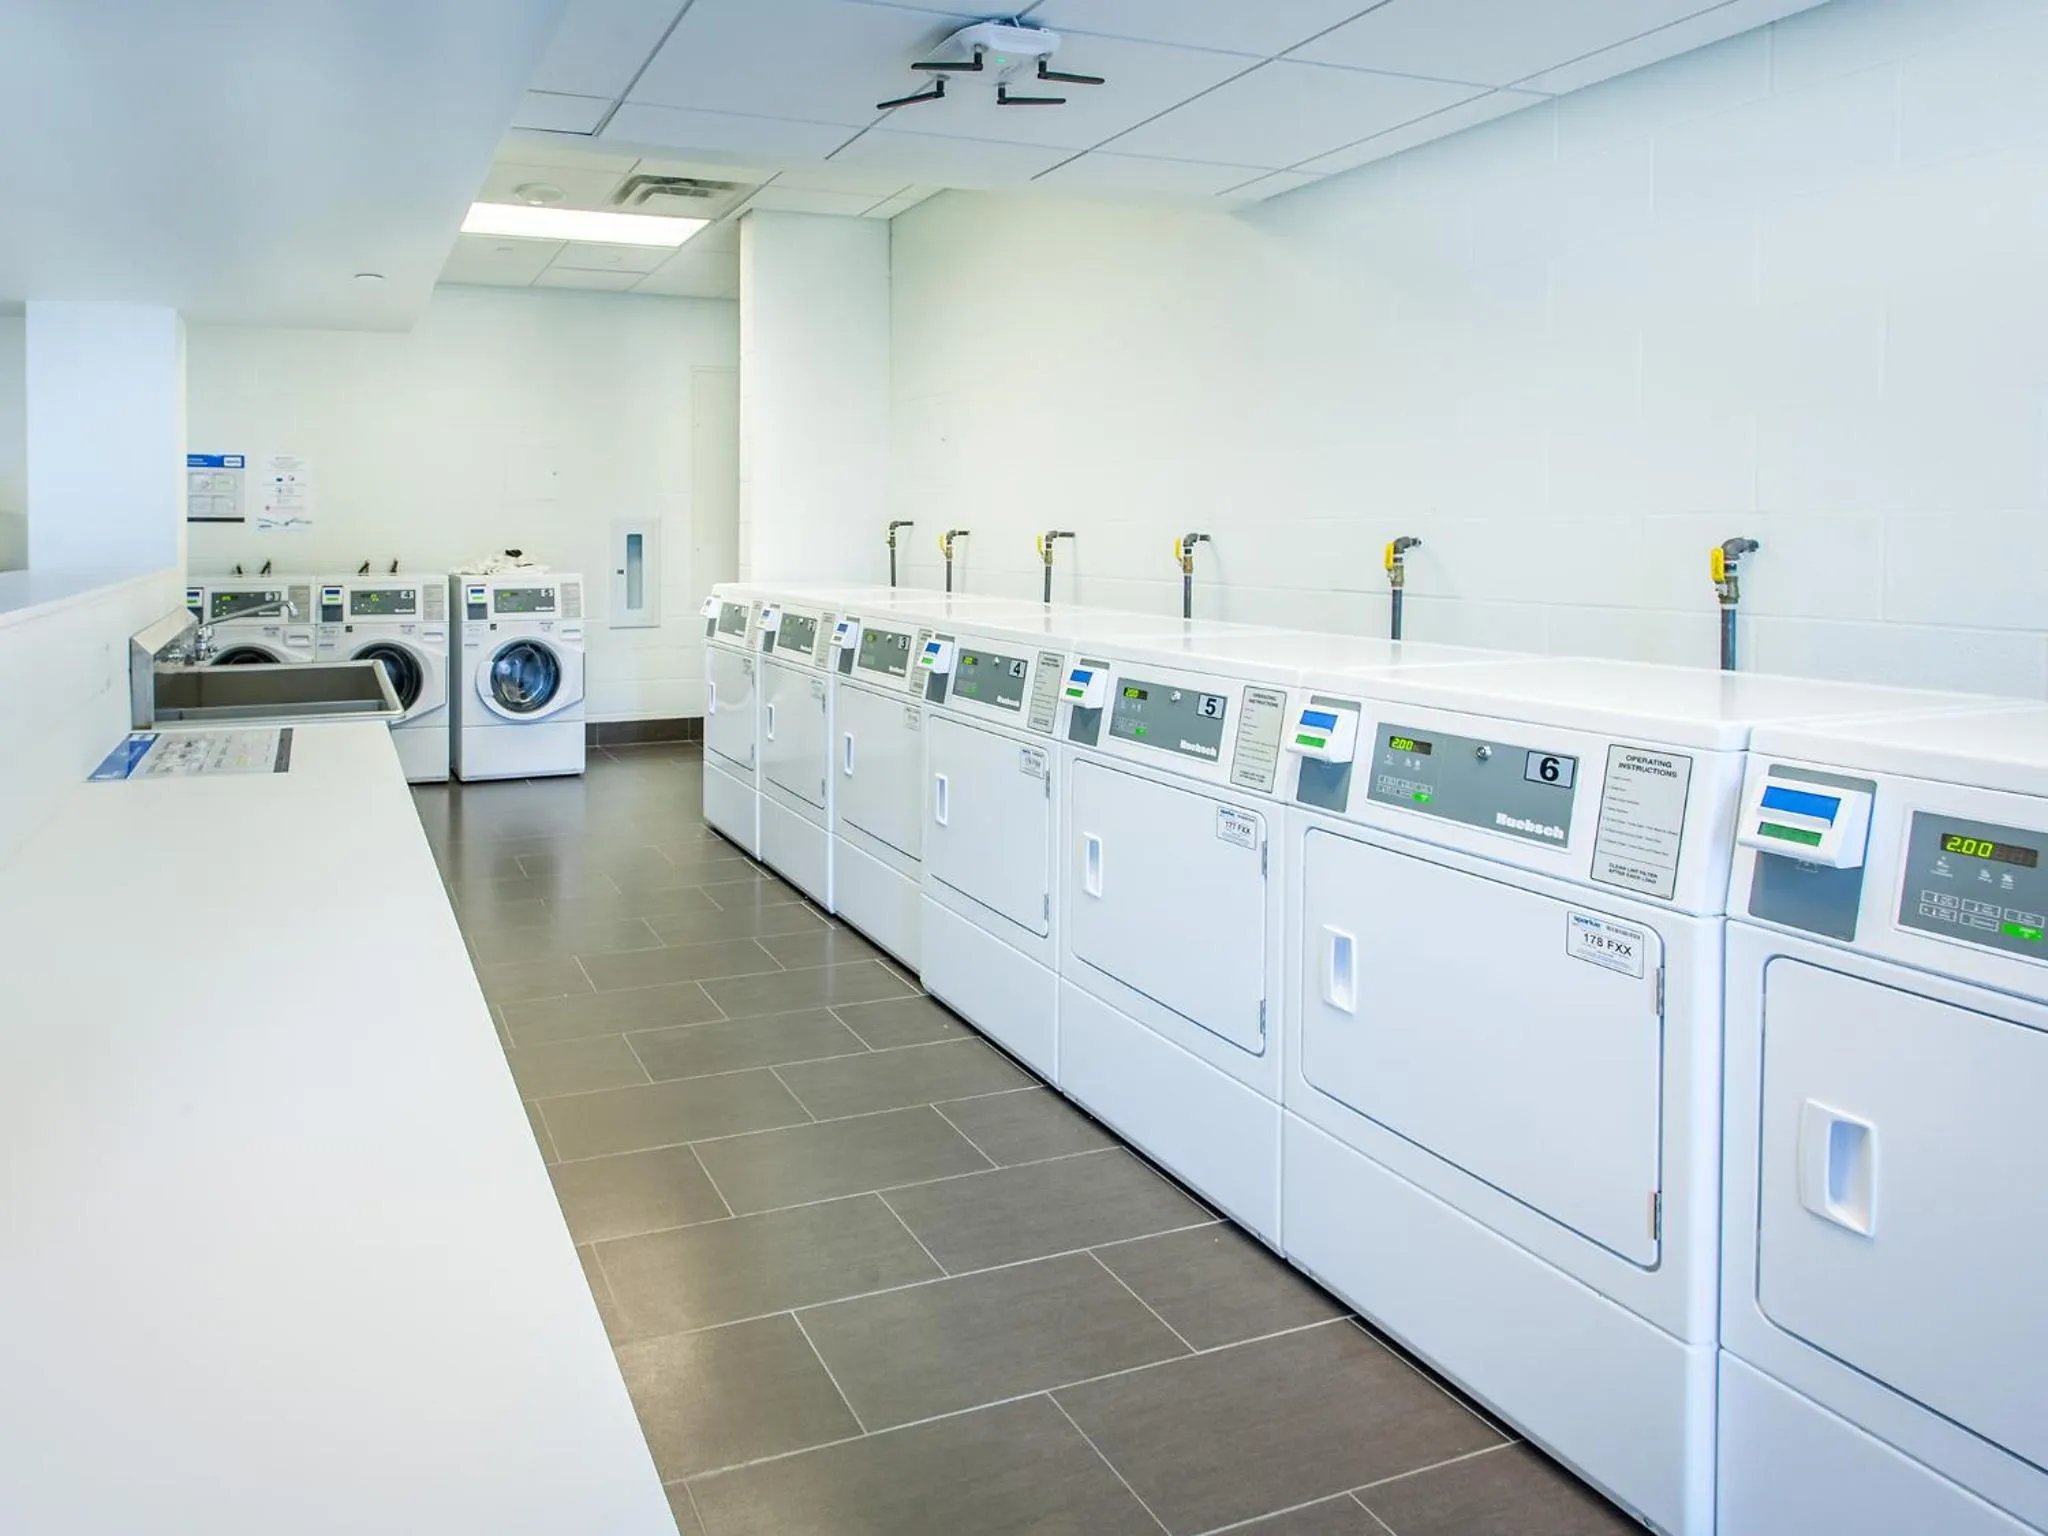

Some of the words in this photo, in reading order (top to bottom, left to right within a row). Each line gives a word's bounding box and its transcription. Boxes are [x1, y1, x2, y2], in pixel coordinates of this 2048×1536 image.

[1013, 661, 1022, 676] 4
[1204, 697, 1218, 716] 5
[1540, 756, 1560, 782] 6
[1618, 762, 1678, 779] INSTRUCTIONS
[1625, 754, 1673, 769] OPERATING
[1946, 836, 1994, 858] 2.00
[1583, 933, 1604, 947] 178
[1607, 940, 1632, 956] FXX
